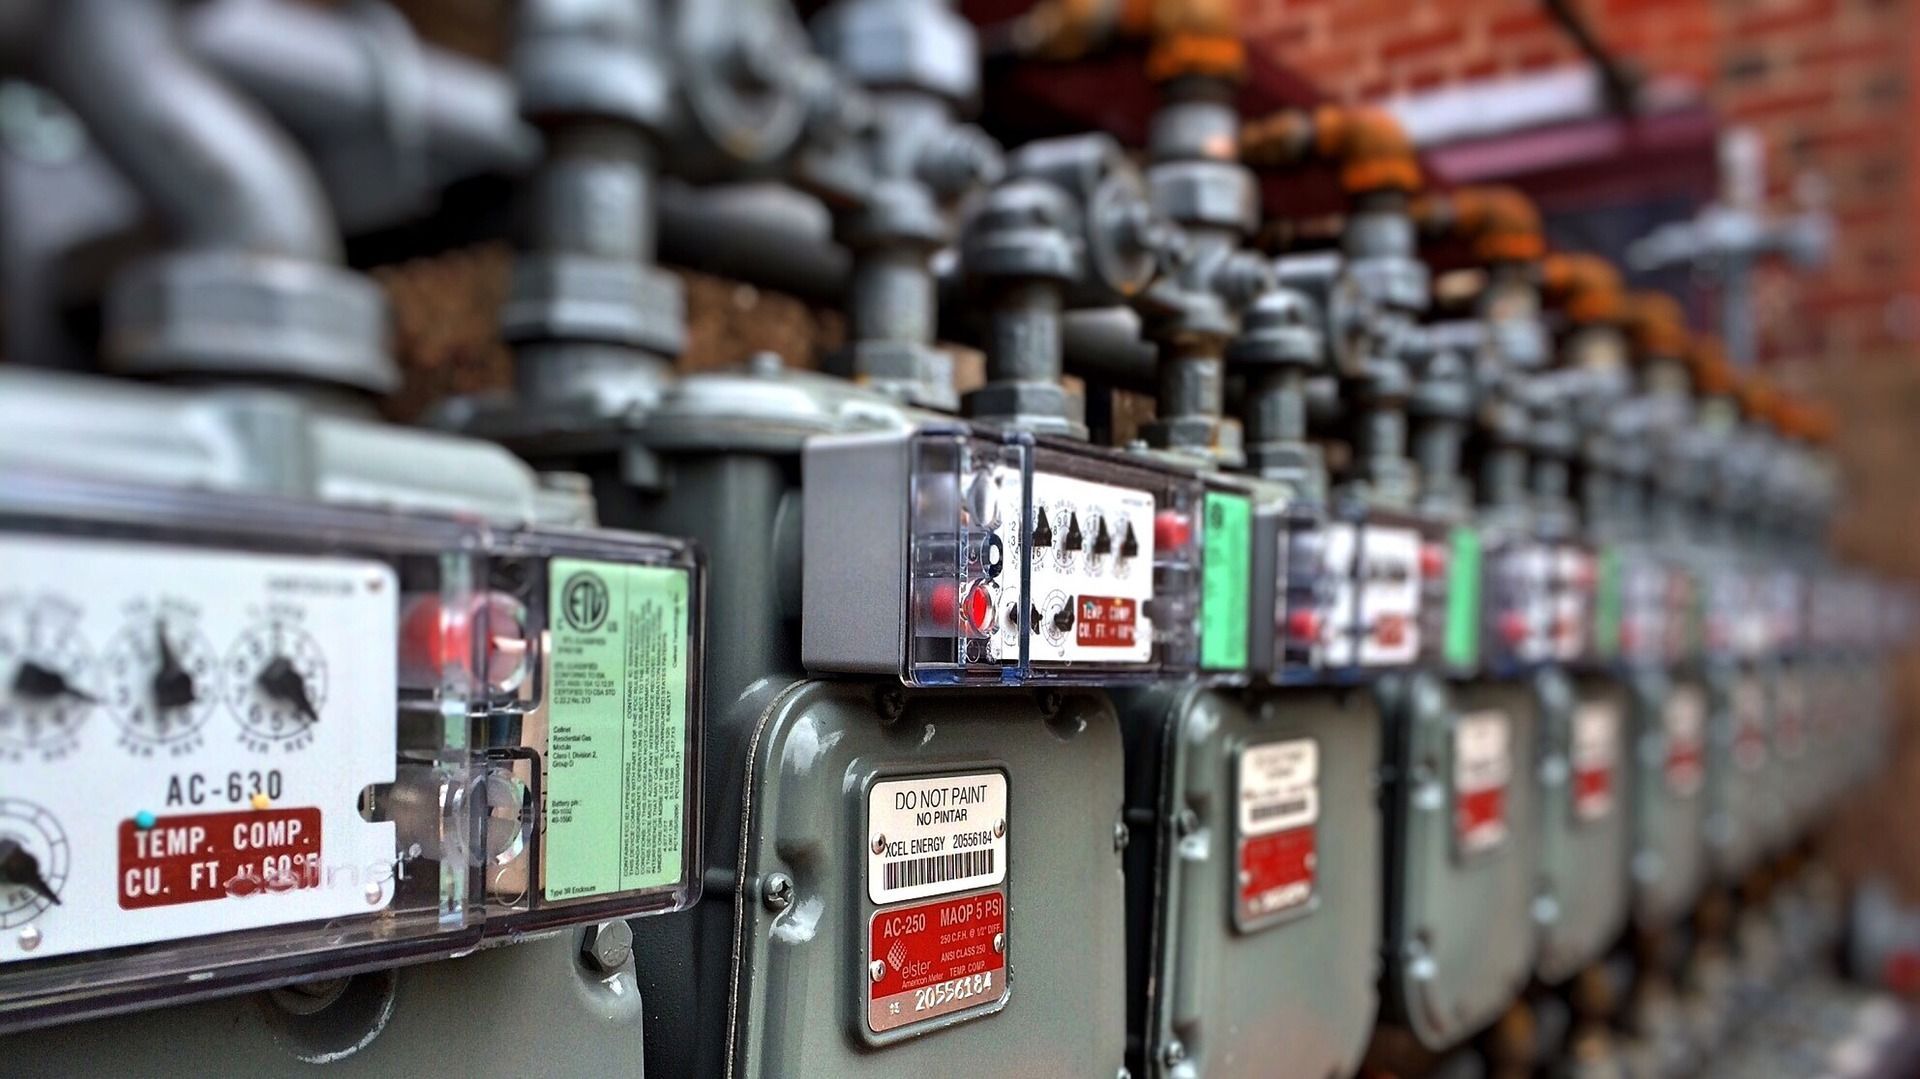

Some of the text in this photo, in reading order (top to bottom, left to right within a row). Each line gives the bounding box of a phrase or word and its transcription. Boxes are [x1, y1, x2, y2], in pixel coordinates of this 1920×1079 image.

[166, 769, 283, 807] AC-630
[895, 784, 988, 810] DO NOT PAINT
[916, 808, 968, 826] NO PINTAR
[134, 819, 310, 859] TEMP. COMP.
[885, 830, 992, 858] XCEL ENERGY 20556184
[124, 866, 170, 898] CU.
[883, 898, 1002, 939] AC-250 MAOP 5 PSI
[940, 934, 951, 945] 250
[969, 928, 976, 938] @
[940, 943, 986, 963] ANSI CLASS 250
[902, 960, 932, 979] elster
[949, 965, 967, 977] TEMP.
[901, 976, 928, 990] American
[915, 971, 992, 1012] 20556184
